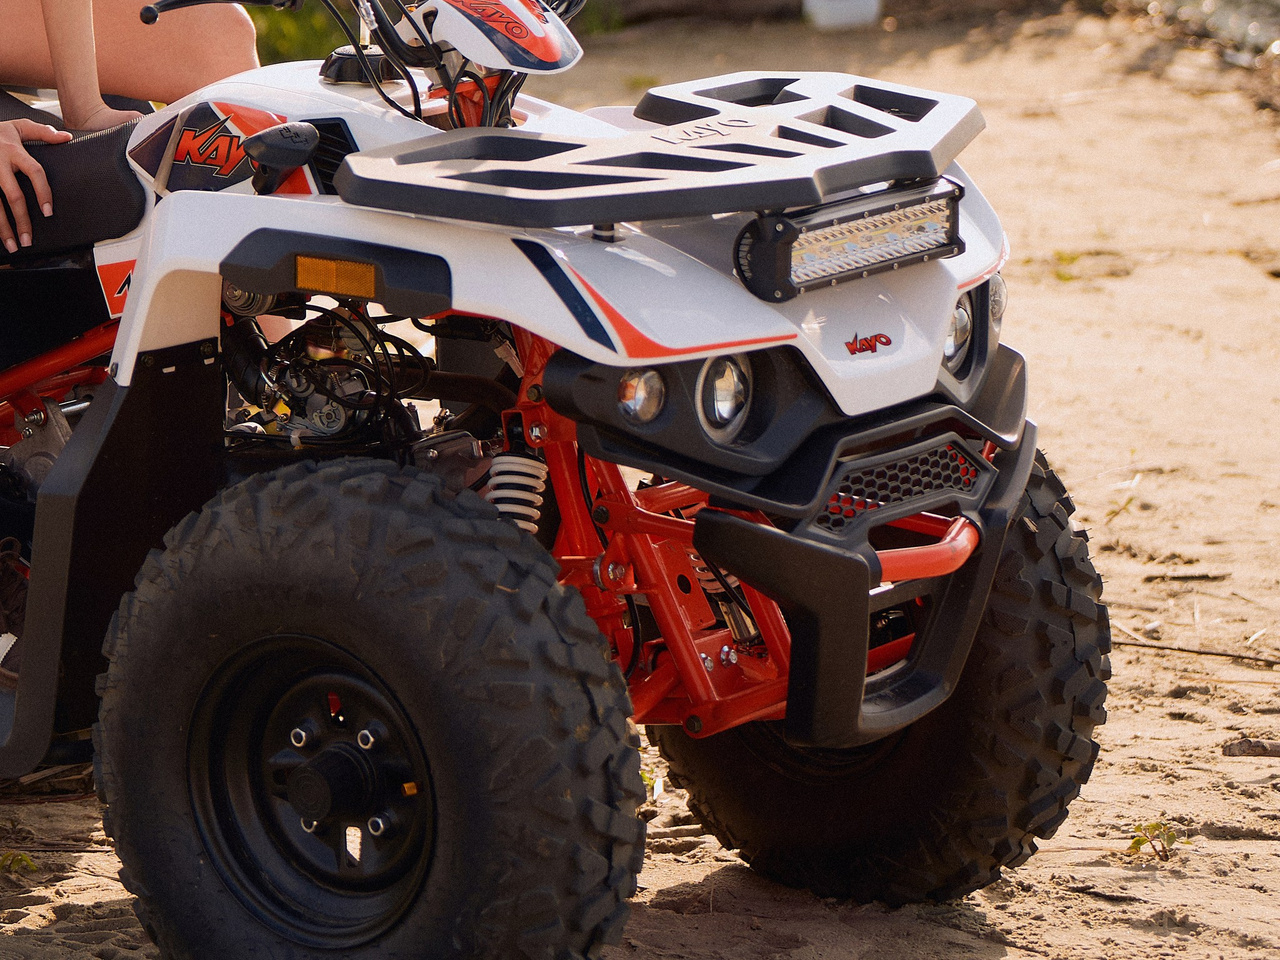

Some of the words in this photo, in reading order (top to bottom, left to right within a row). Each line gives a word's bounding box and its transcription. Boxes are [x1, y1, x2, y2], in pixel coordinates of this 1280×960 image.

[650, 118, 756, 145] KAYO
[172, 113, 258, 178] KAY
[844, 331, 892, 356] KAYO
